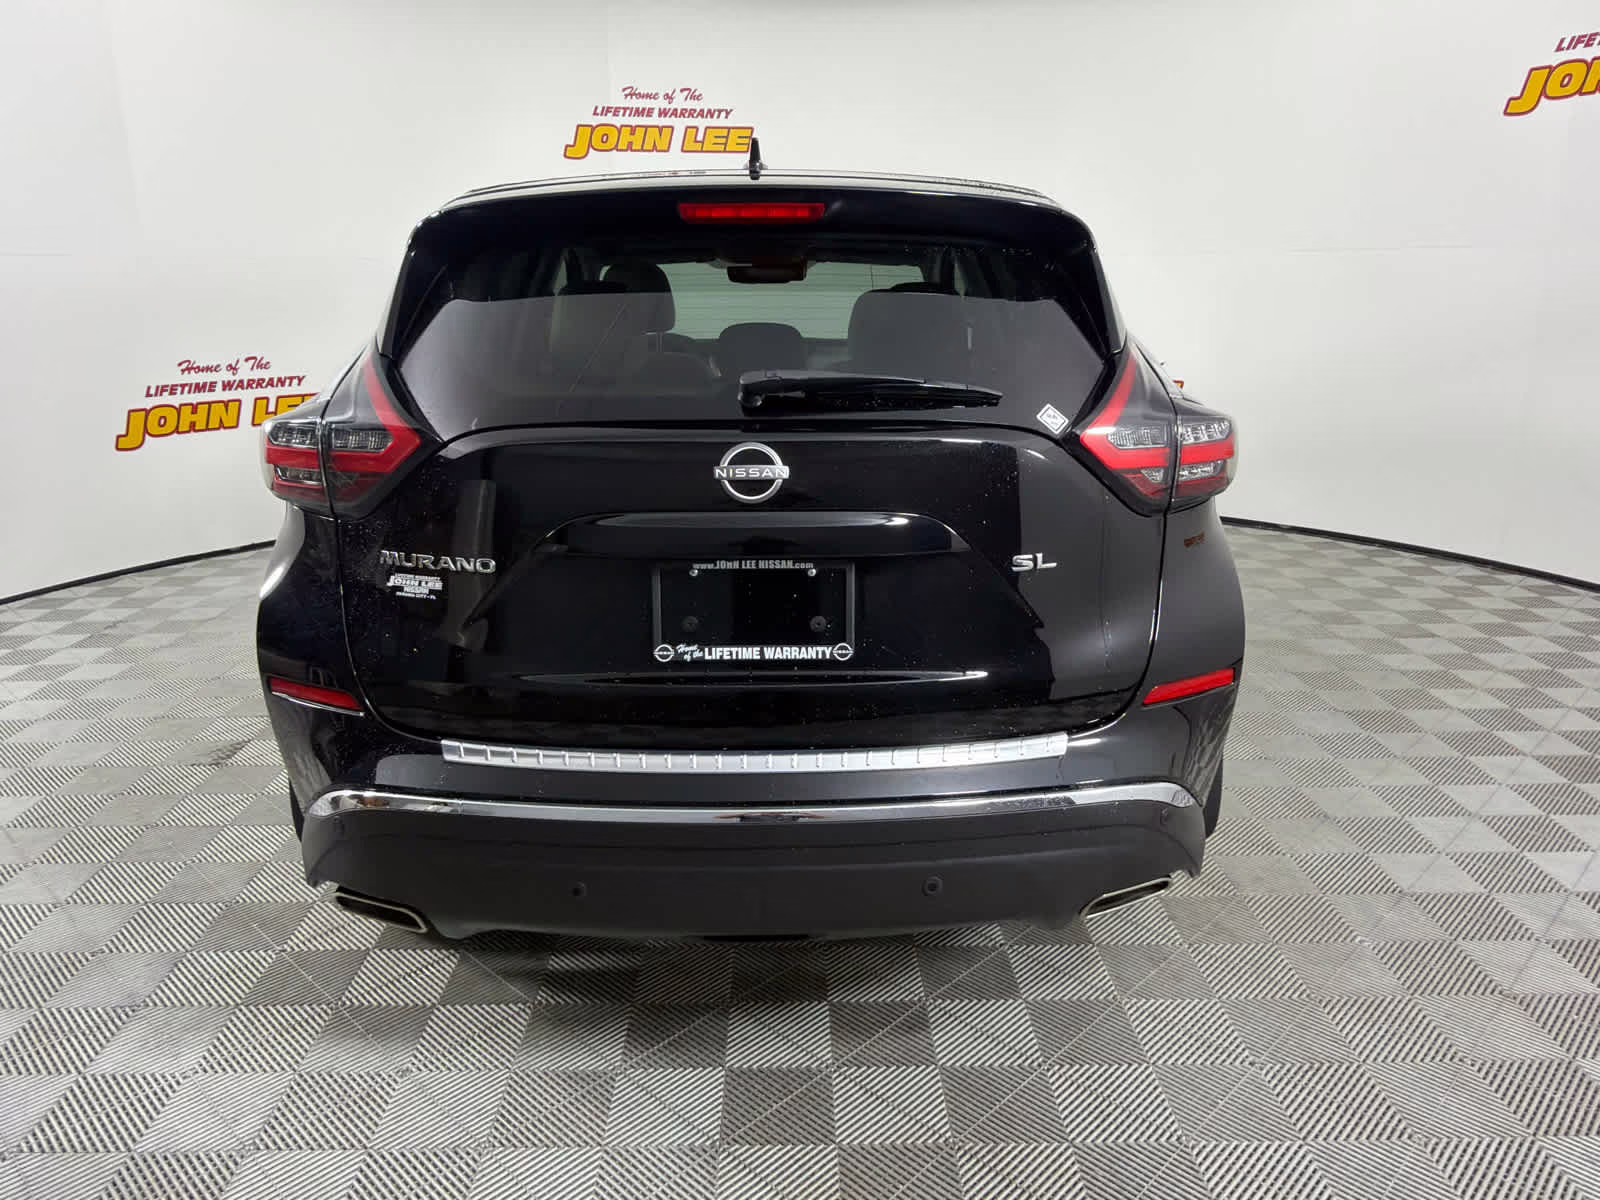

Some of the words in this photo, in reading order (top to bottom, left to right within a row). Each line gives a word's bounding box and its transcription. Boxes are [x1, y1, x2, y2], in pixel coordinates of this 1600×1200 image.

[621, 86, 660, 102] Home
[663, 88, 676, 104] of
[680, 88, 704, 102] The
[592, 105, 655, 118] LIFETIME
[657, 107, 733, 120] WARRANTY
[564, 123, 674, 160] JOHN
[681, 126, 754, 154] LEE
[177, 357, 222, 374] Home
[225, 358, 240, 376] of
[244, 355, 272, 371] The
[145, 380, 217, 398] LIFETIME
[221, 375, 306, 393] WARRANTY
[115, 398, 242, 452] JOHN
[715, 467, 788, 478] NISSAN
[379, 549, 497, 574] MURANO
[742, 560, 757, 570] LEE
[1011, 552, 1058, 572] SL
[704, 647, 760, 660] LIFETIME
[764, 646, 833, 659] WARRANTY
